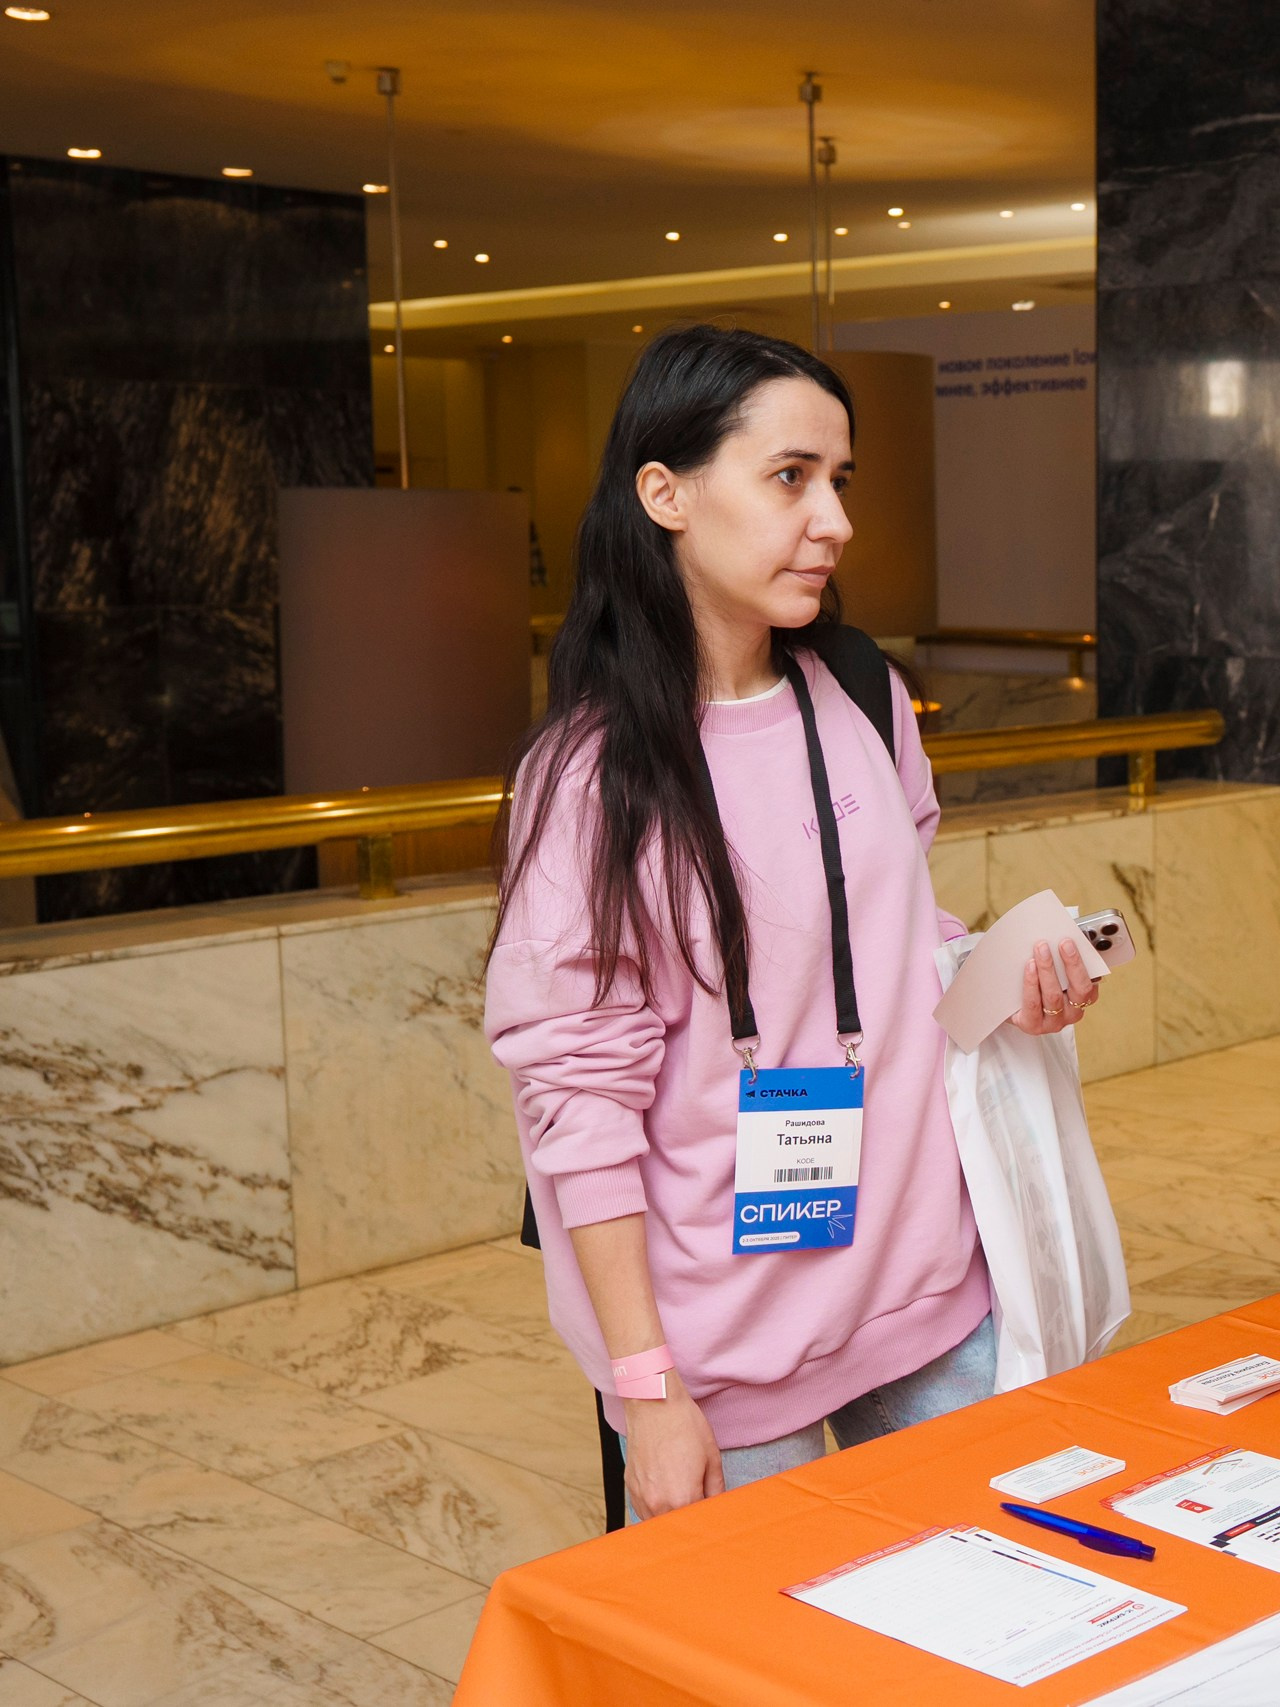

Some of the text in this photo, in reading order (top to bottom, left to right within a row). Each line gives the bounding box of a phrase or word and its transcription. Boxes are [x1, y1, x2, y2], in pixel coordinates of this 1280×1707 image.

[938, 359, 982, 373] новое
[985, 352, 1070, 370] поколение
[981, 376, 1087, 397] эффективнее
[802, 793, 860, 840] KDE
[760, 1089, 808, 1098] СТАЧКА
[785, 1119, 825, 1128] Рашидова
[777, 1133, 832, 1146] Татьяна
[796, 1157, 815, 1165] KODE
[740, 1199, 841, 1224] СПИКЕР
